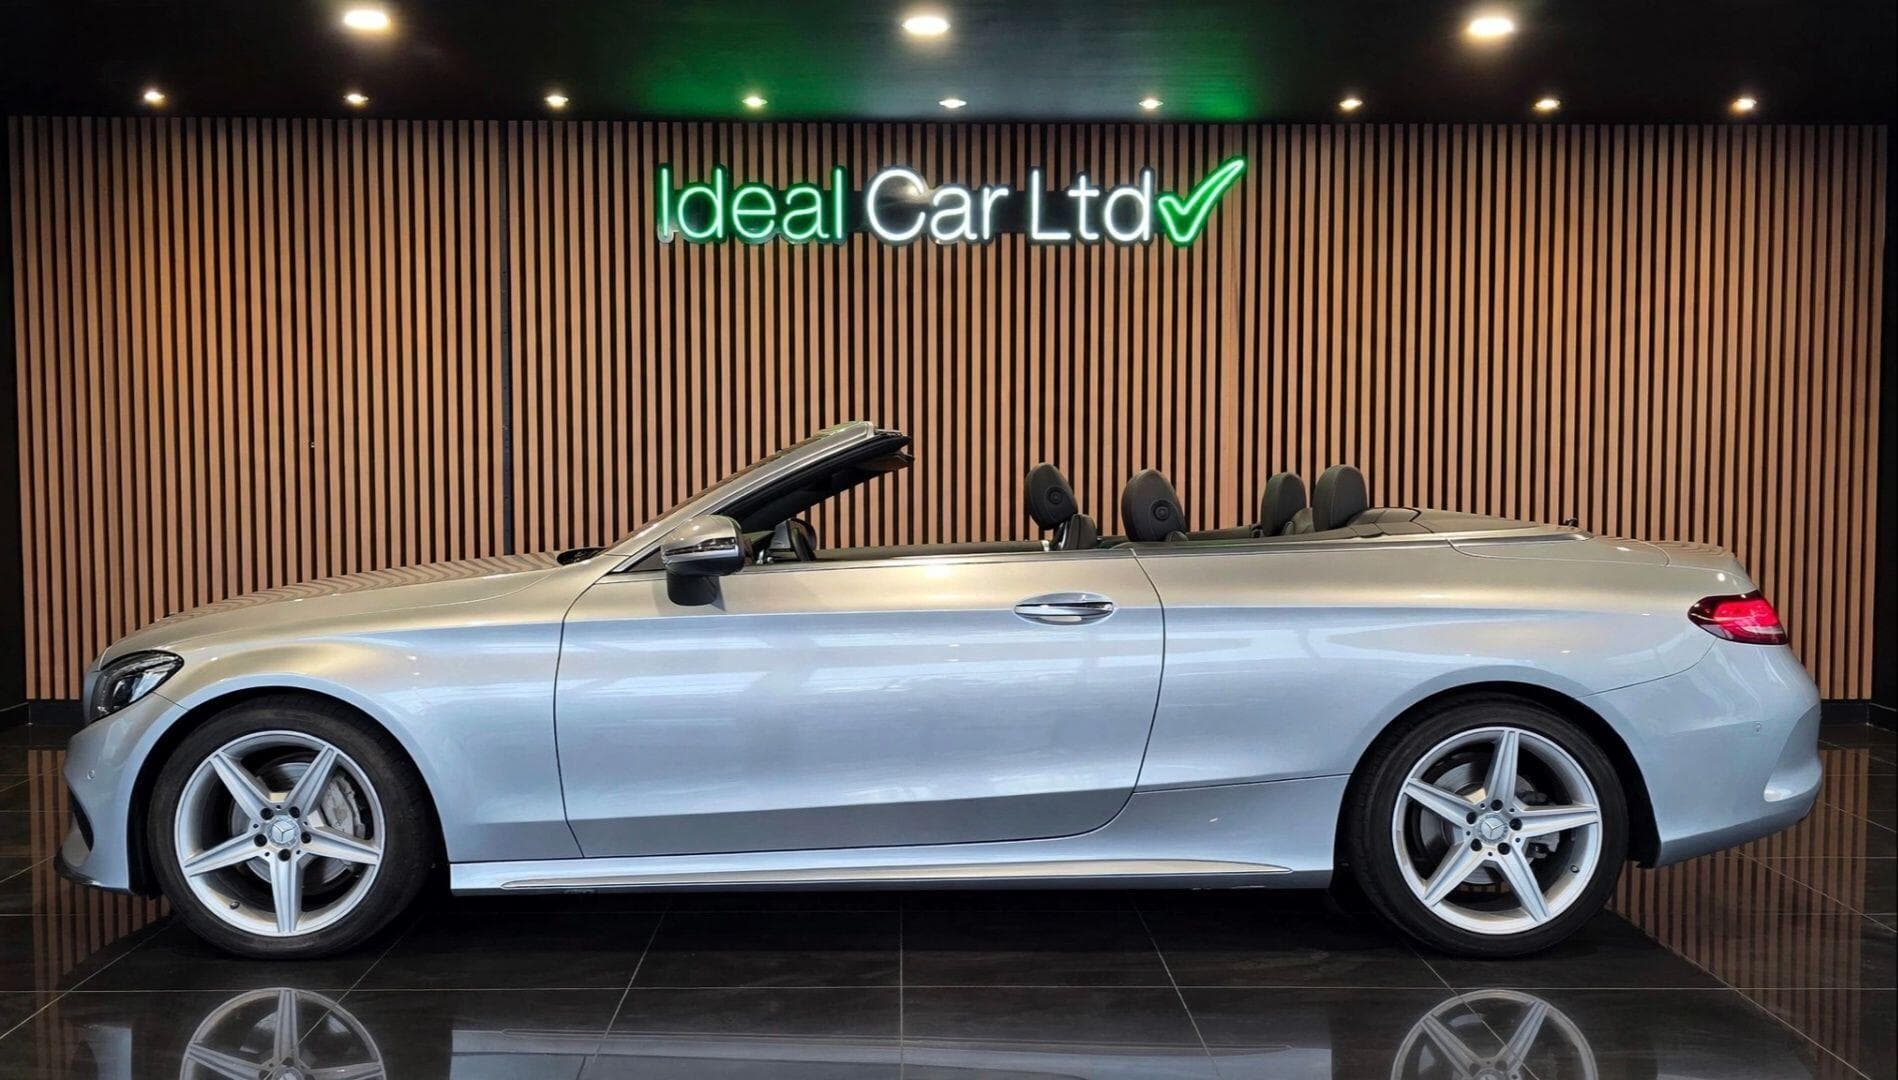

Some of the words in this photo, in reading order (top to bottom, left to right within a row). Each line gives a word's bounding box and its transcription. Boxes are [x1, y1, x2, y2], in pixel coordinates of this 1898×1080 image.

[659, 167, 844, 241] Ideal
[866, 168, 1009, 242] Car
[1031, 167, 1151, 241] Ltd
